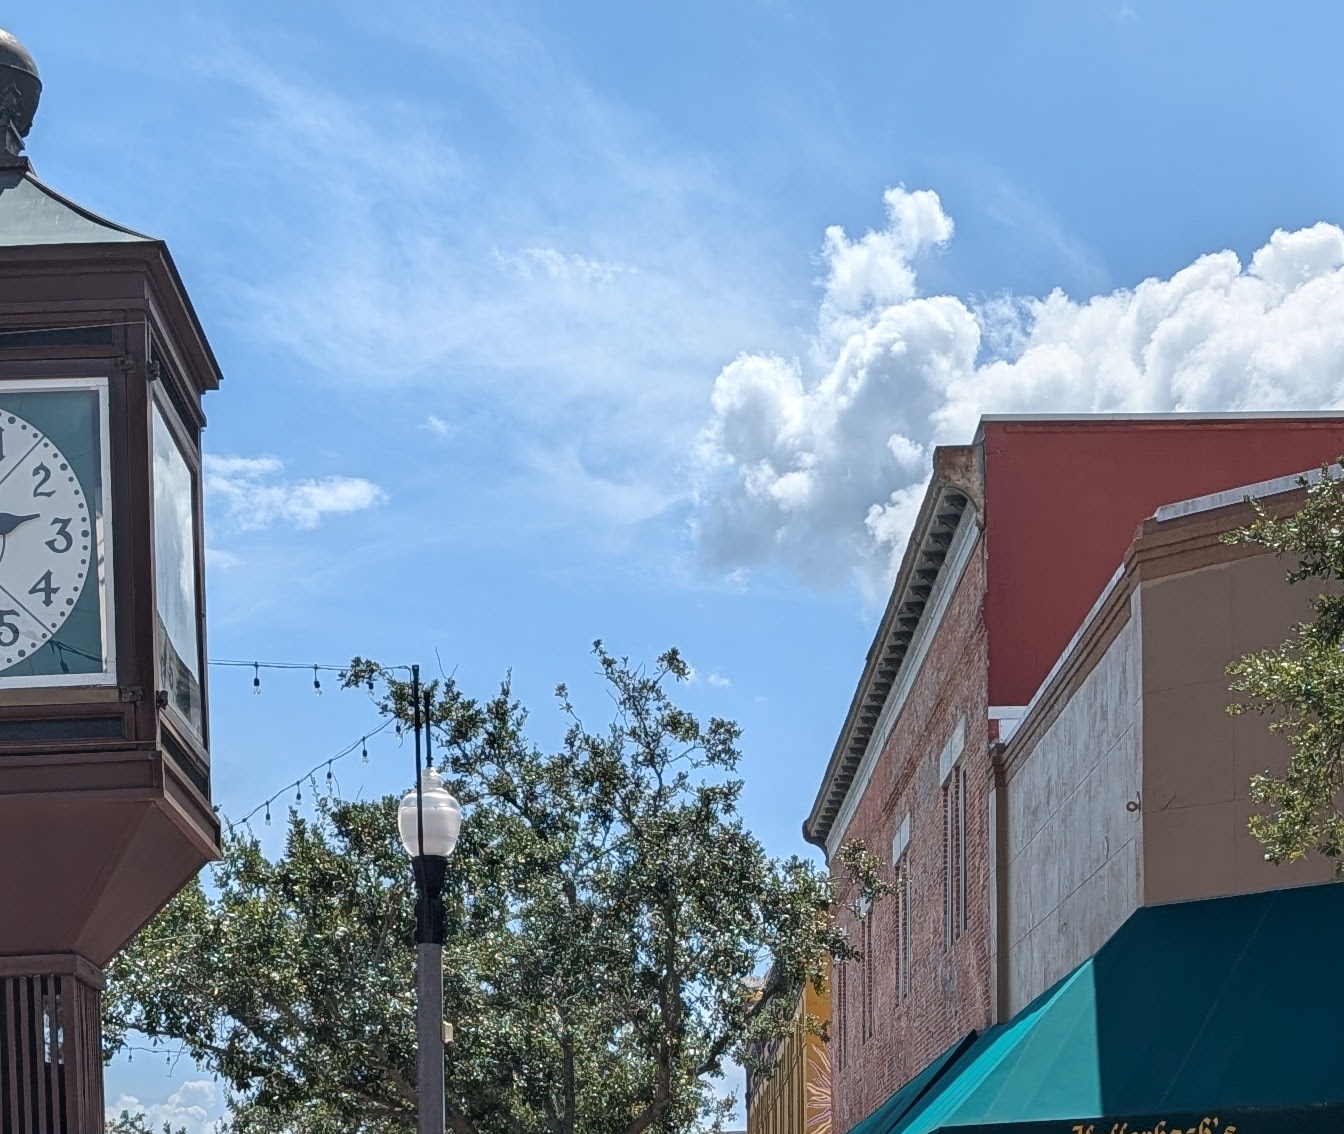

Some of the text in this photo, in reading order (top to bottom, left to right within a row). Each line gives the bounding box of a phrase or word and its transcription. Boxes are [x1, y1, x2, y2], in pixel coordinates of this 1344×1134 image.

[32, 462, 56, 498] 2
[44, 517, 73, 554] 3
[28, 569, 60, 608] 4
